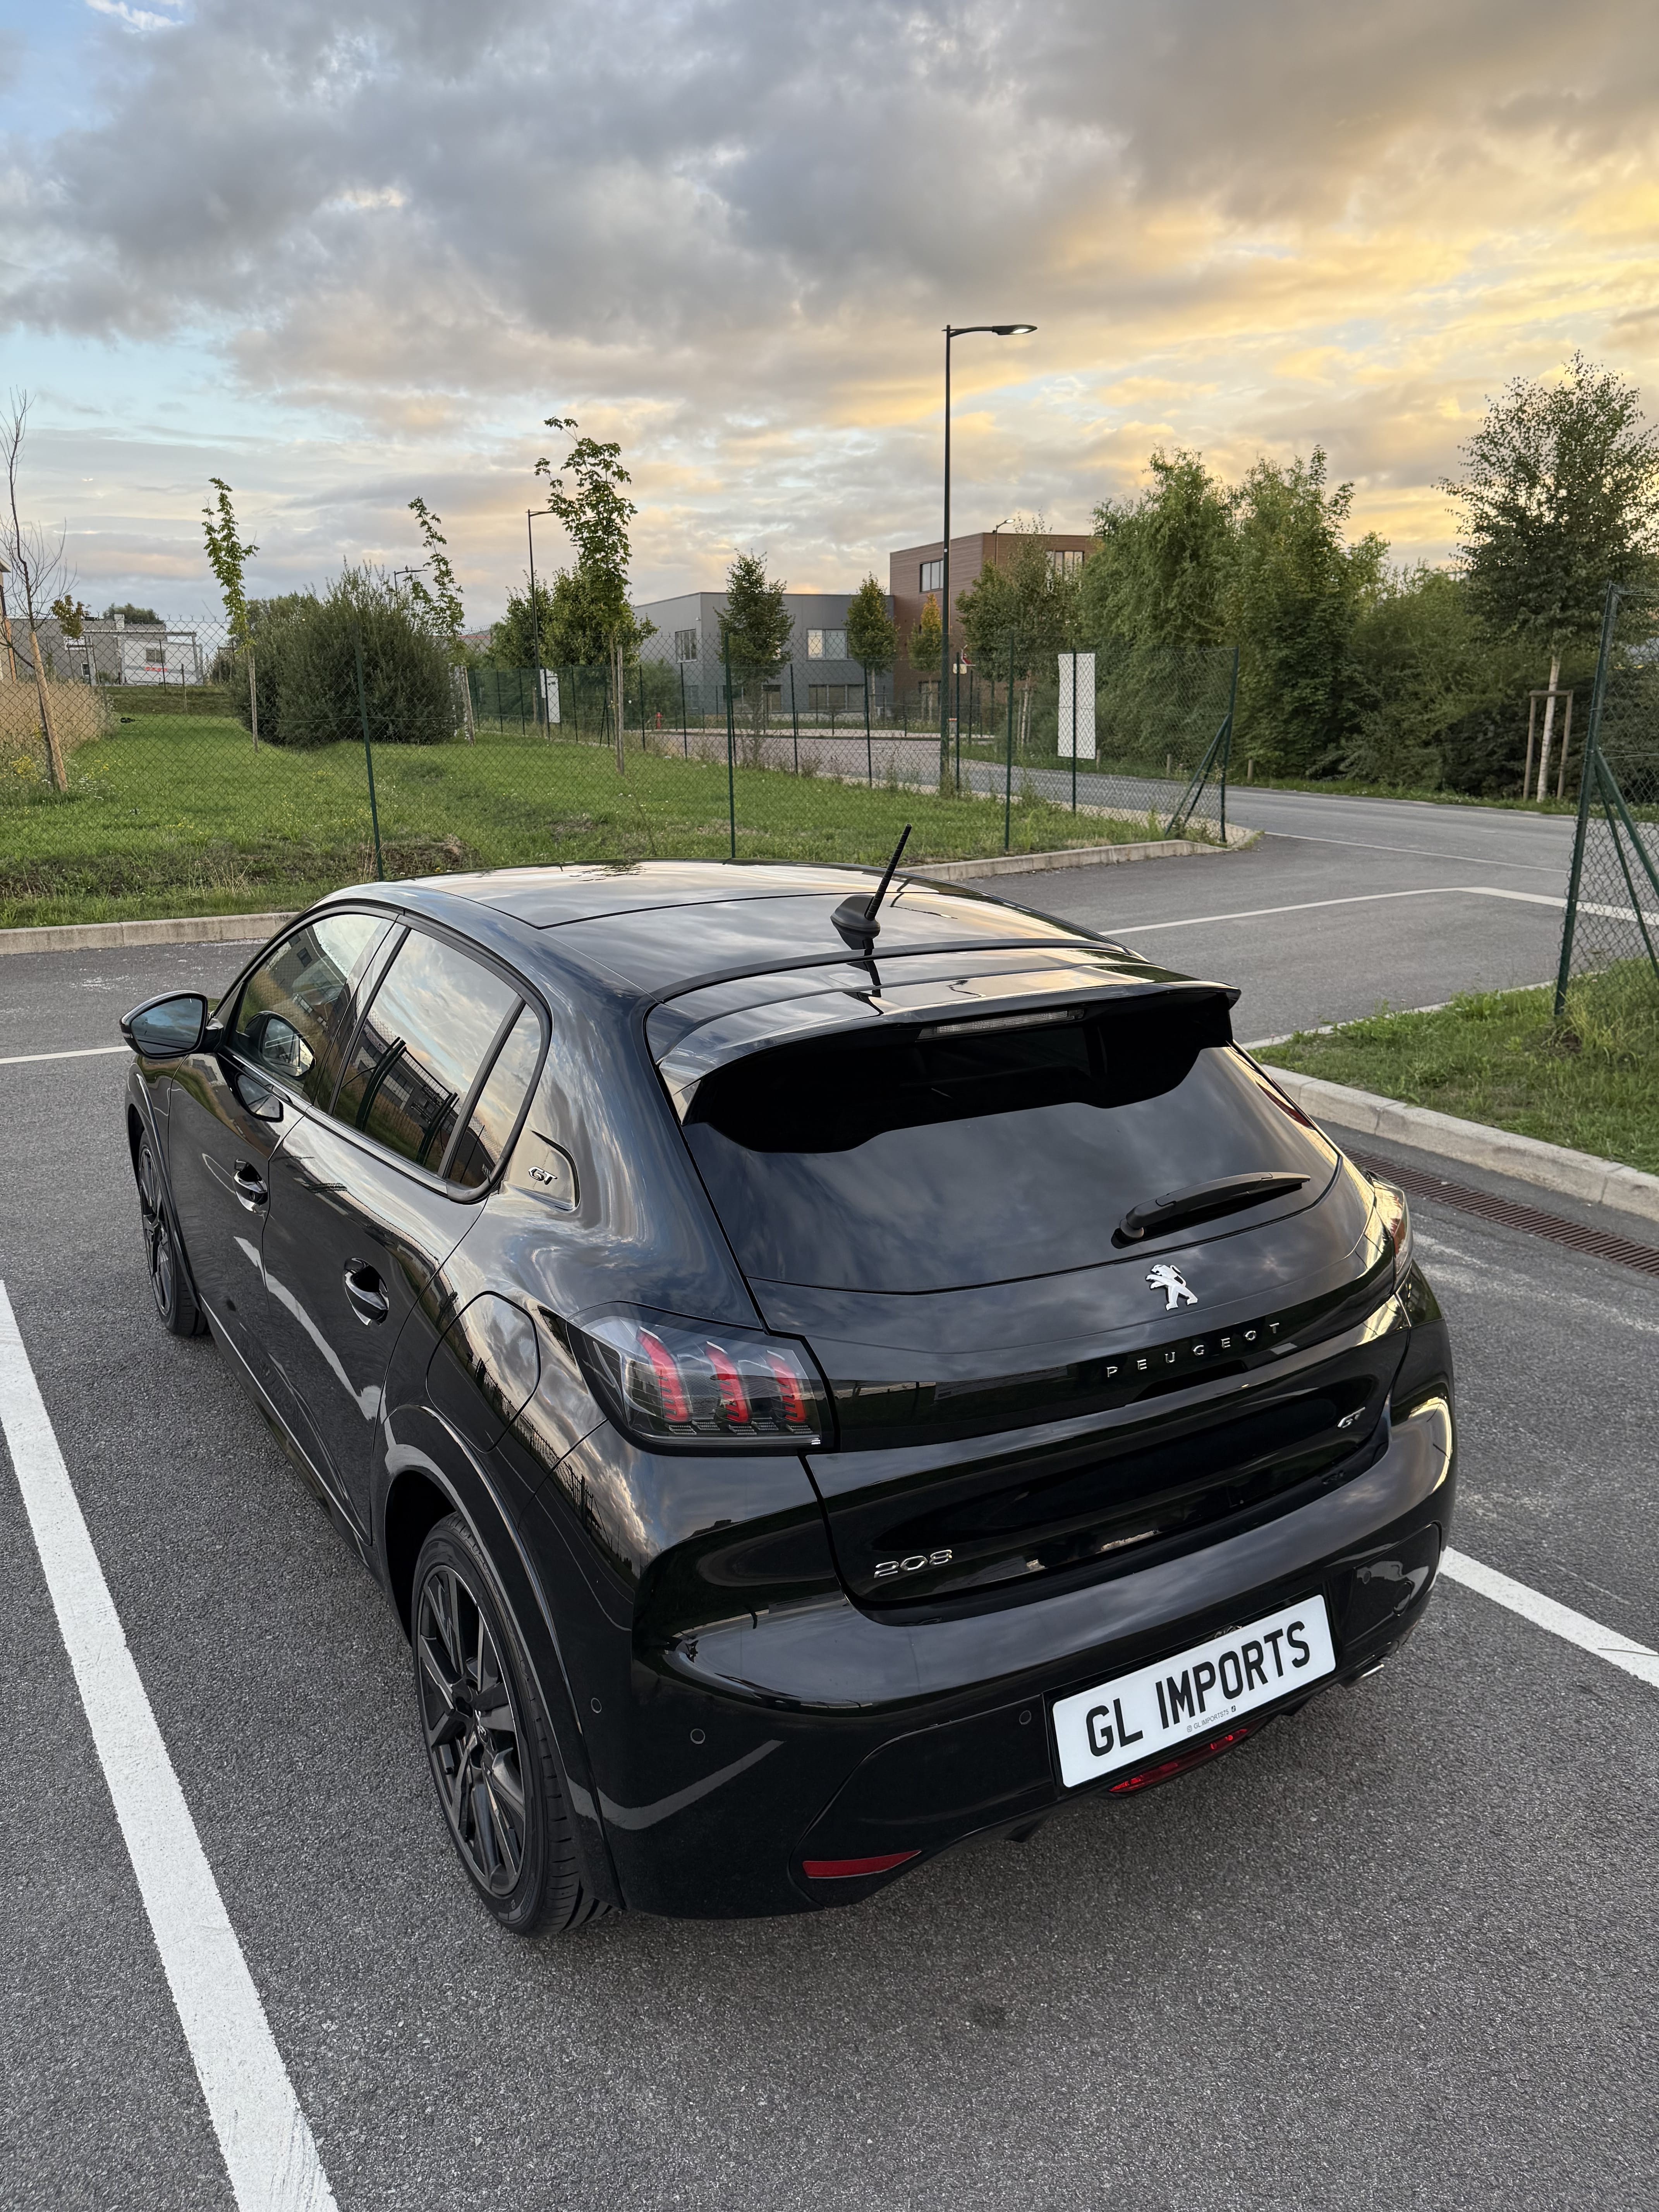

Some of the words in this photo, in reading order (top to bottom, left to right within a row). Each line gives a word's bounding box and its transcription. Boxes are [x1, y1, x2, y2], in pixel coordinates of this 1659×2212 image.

[528, 1166, 558, 1185] GT
[1106, 1322, 1280, 1378] PEUGEOT
[1337, 1407, 1365, 1428] GT
[874, 1549, 952, 1578] 208
[1085, 1698, 1144, 1757] GL
[1155, 1620, 1310, 1729] IMPORTS
